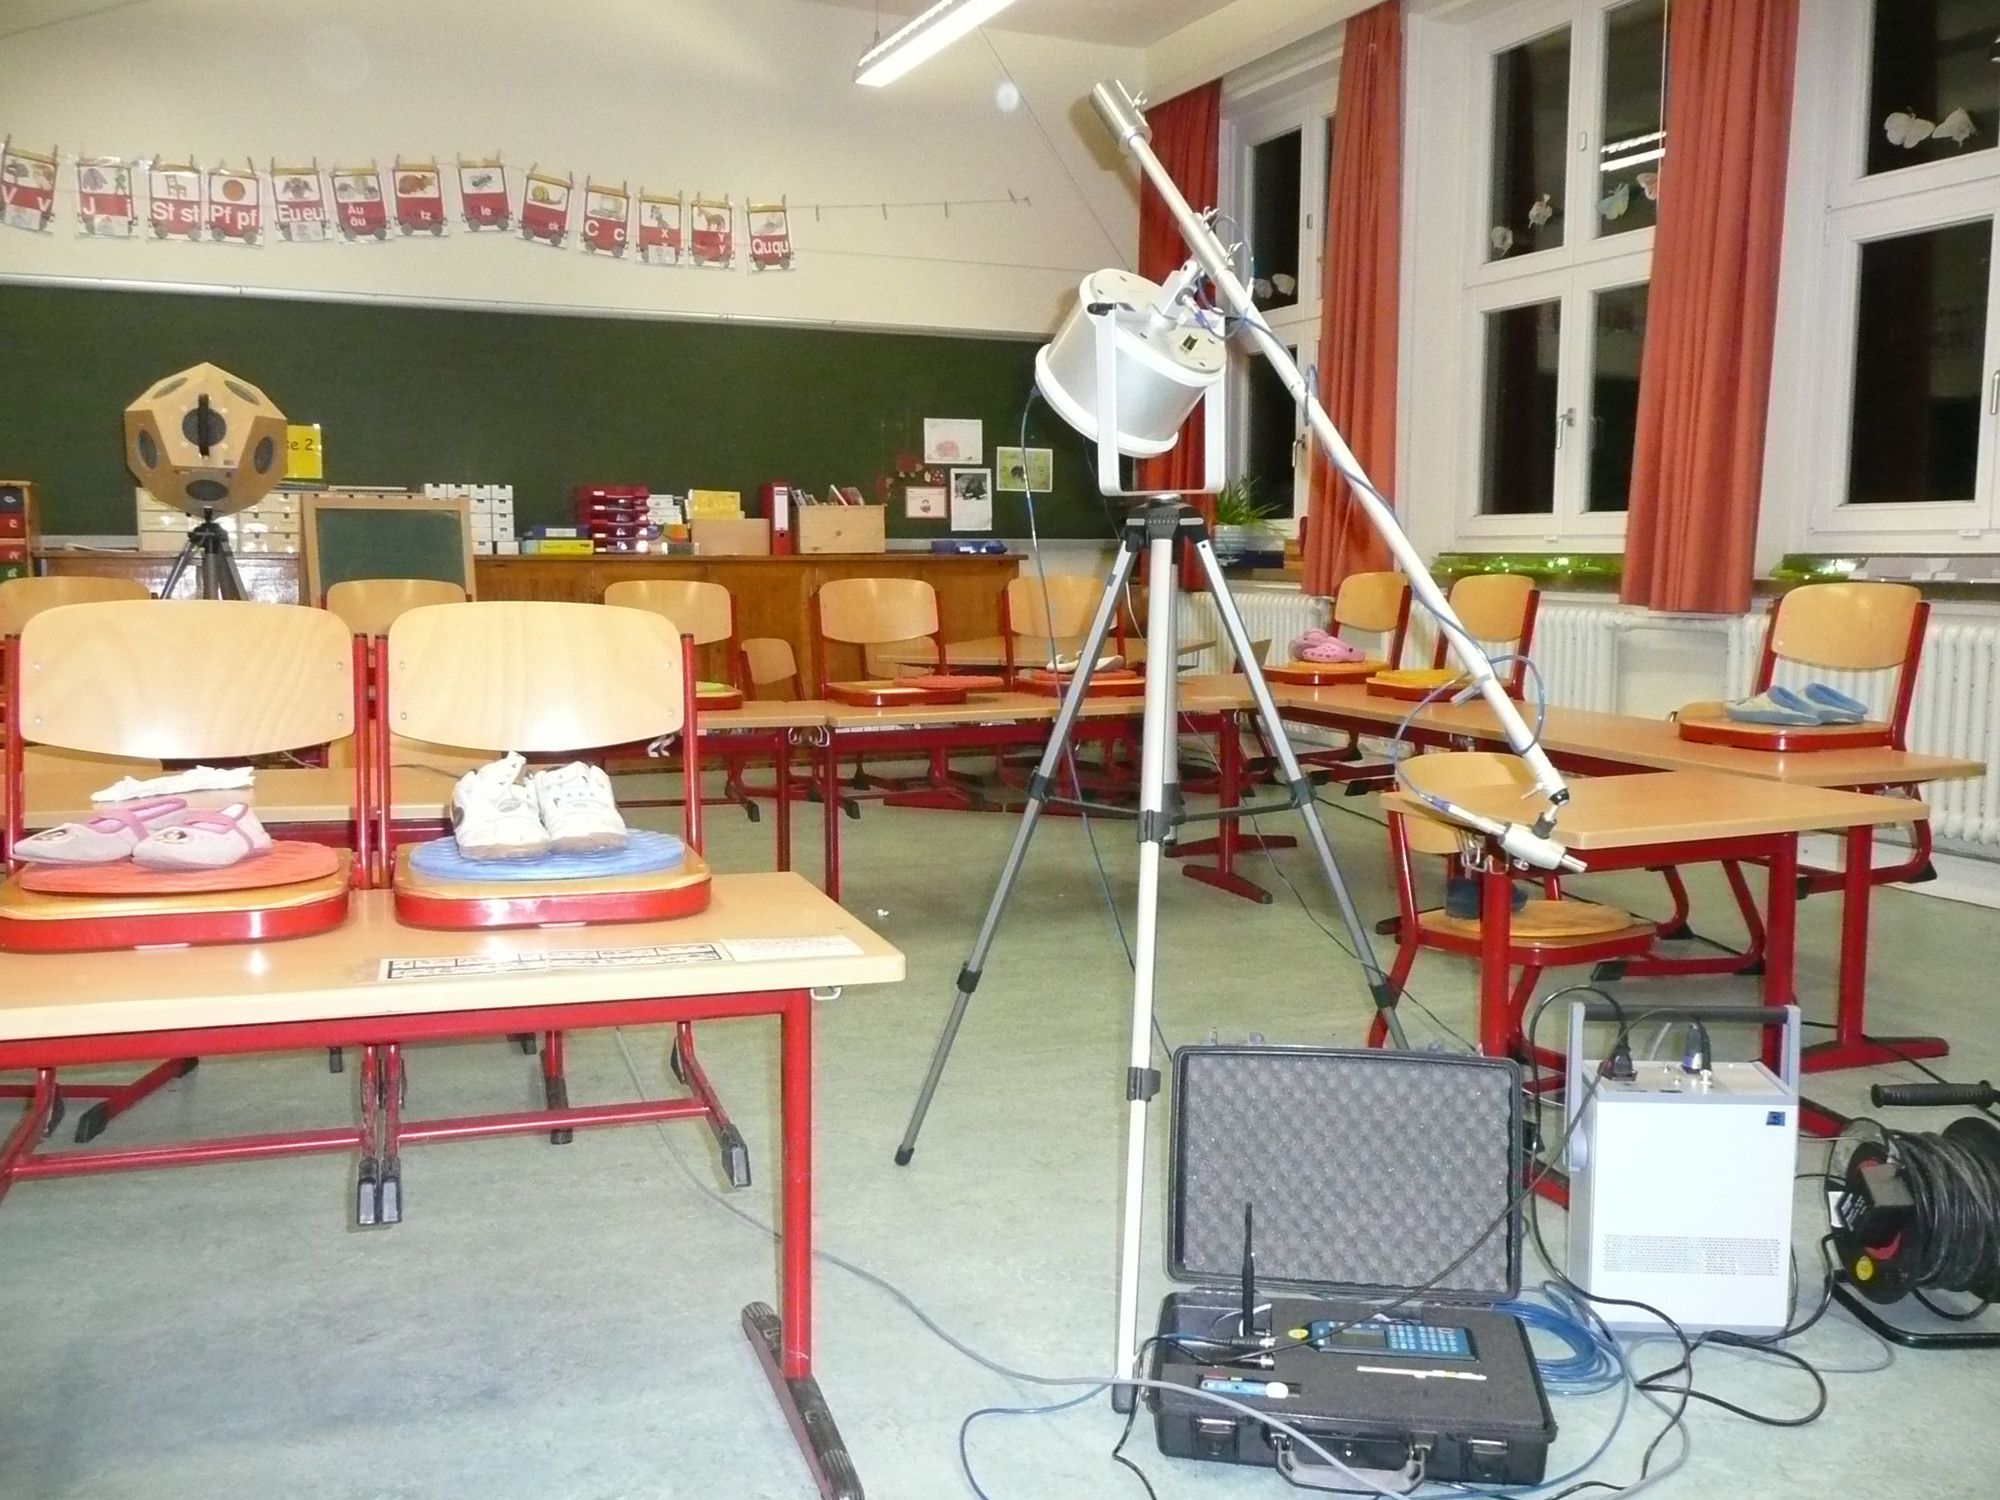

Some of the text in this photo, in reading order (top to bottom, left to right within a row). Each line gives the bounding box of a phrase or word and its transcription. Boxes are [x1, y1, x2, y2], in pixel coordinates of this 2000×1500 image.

[2, 185, 17, 204] V
[82, 197, 96, 215] J
[152, 201, 200, 222] St st
[211, 205, 257, 229] Pf pf
[585, 220, 599, 236] C
[304, 438, 314, 451] 2
